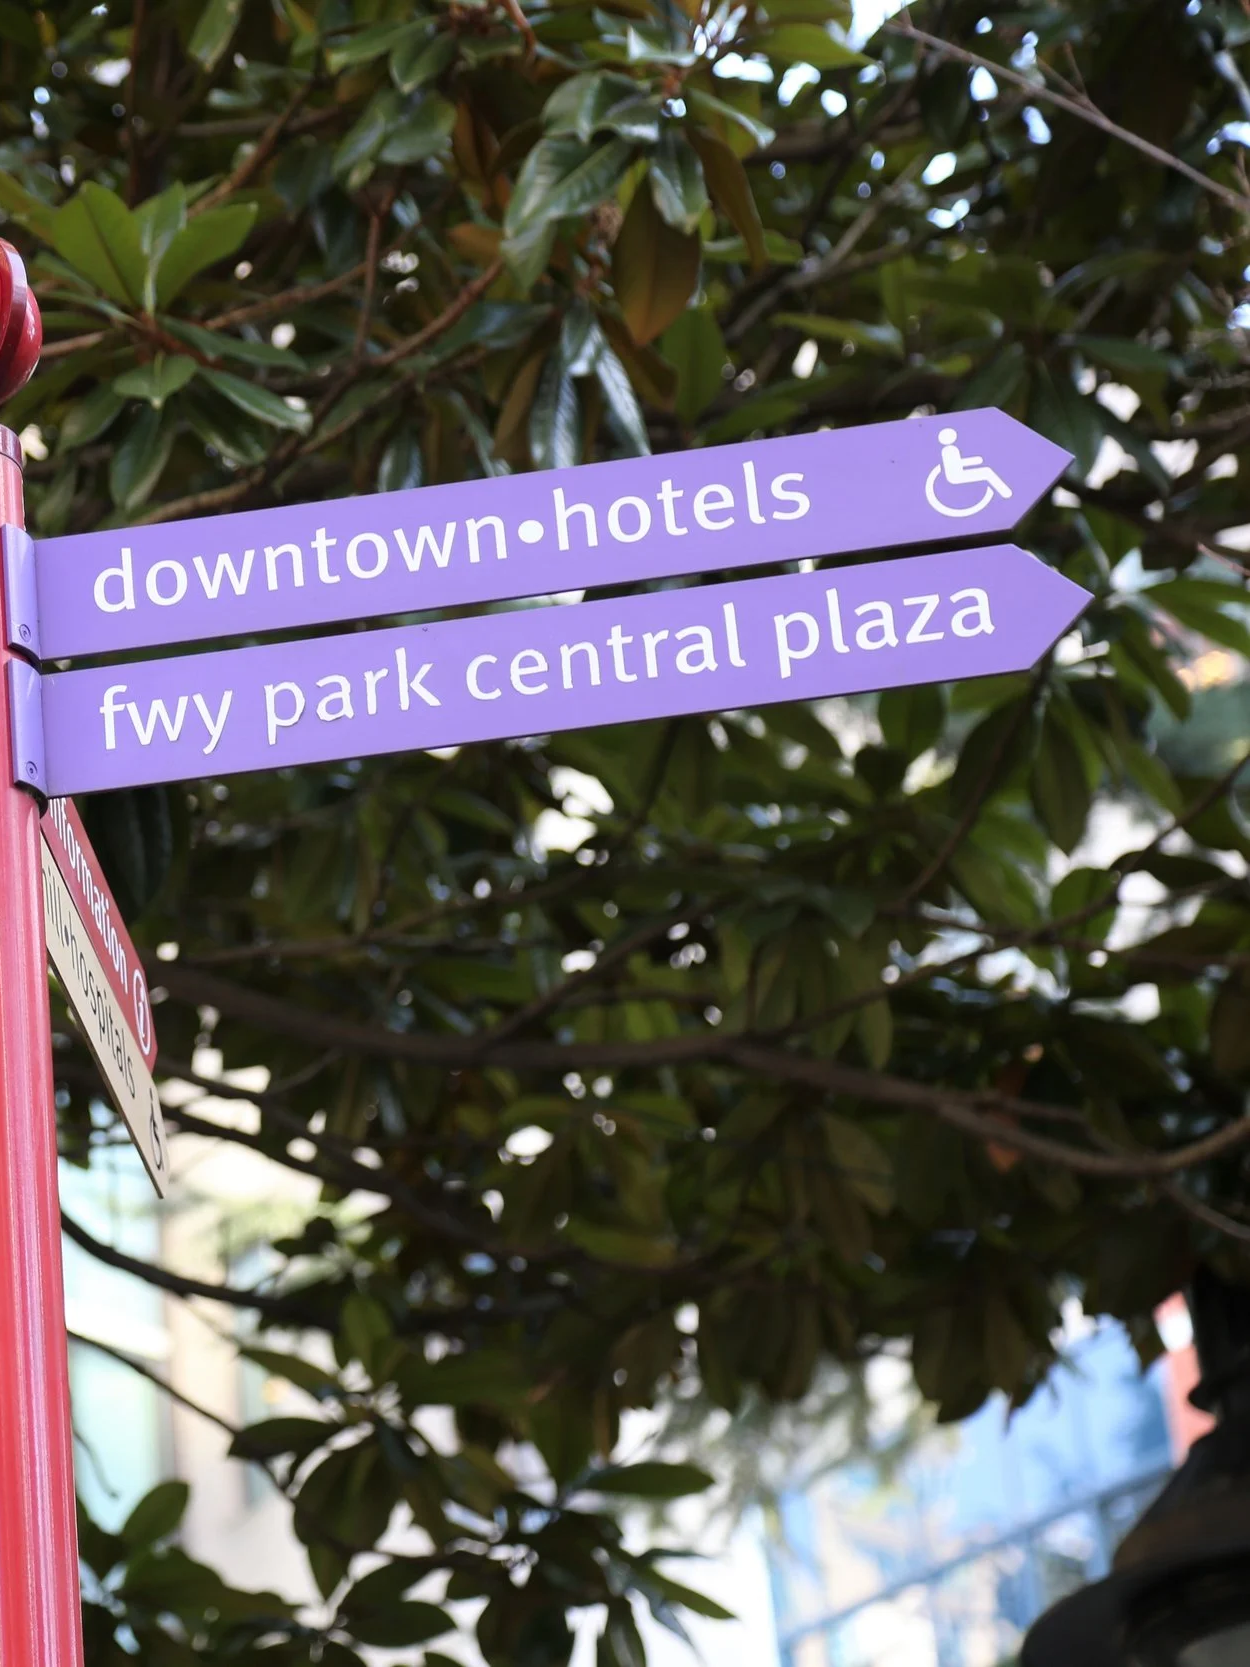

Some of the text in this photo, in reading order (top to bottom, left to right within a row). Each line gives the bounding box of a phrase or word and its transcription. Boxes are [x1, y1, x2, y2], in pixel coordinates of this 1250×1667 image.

[100, 588, 995, 755] fwy park central plaza
